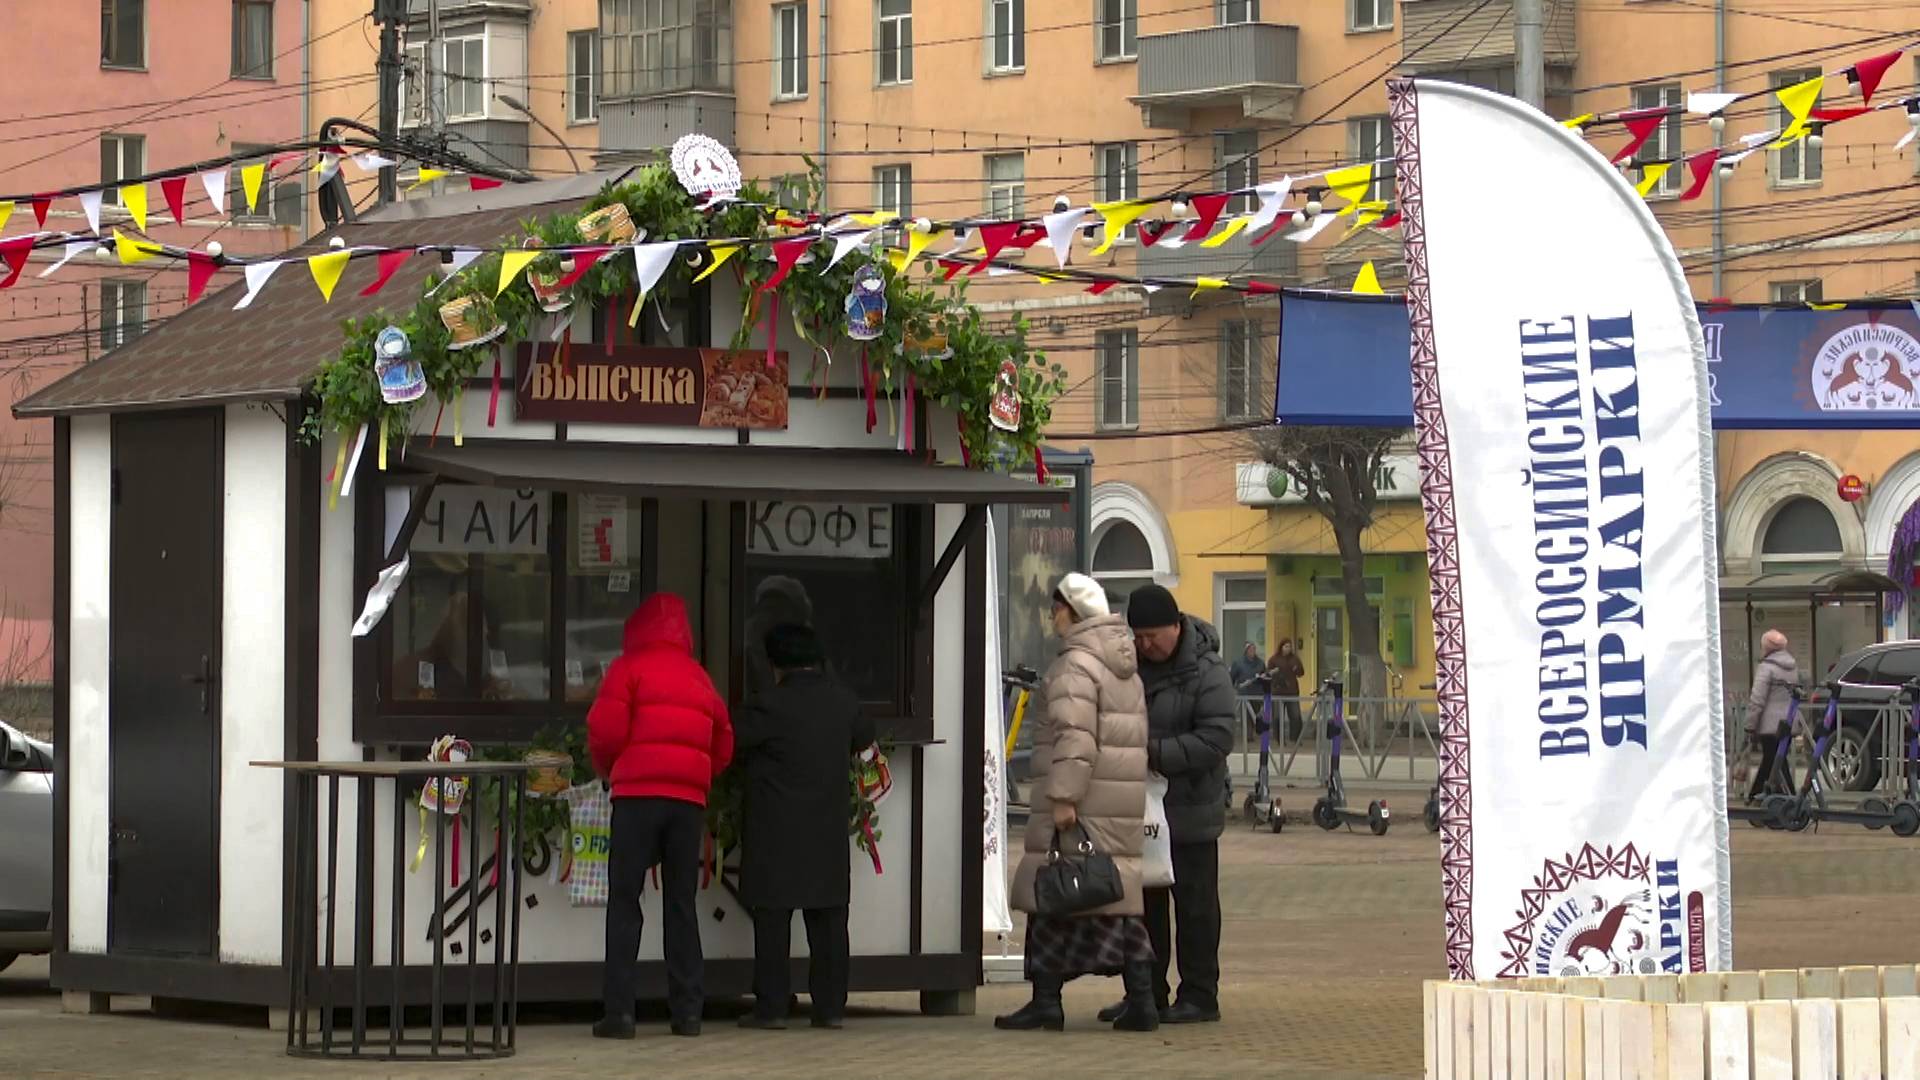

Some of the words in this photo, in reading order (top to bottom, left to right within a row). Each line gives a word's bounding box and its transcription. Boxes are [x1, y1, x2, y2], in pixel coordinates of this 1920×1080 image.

[420, 489, 539, 546] ЧАЙ
[748, 501, 889, 553] КОФЕ
[1519, 315, 1591, 760] ВСЕРОССИЙСКИЕ
[1587, 309, 1647, 751] ЯРМАРКИ
[1655, 858, 1682, 975] АРКИ
